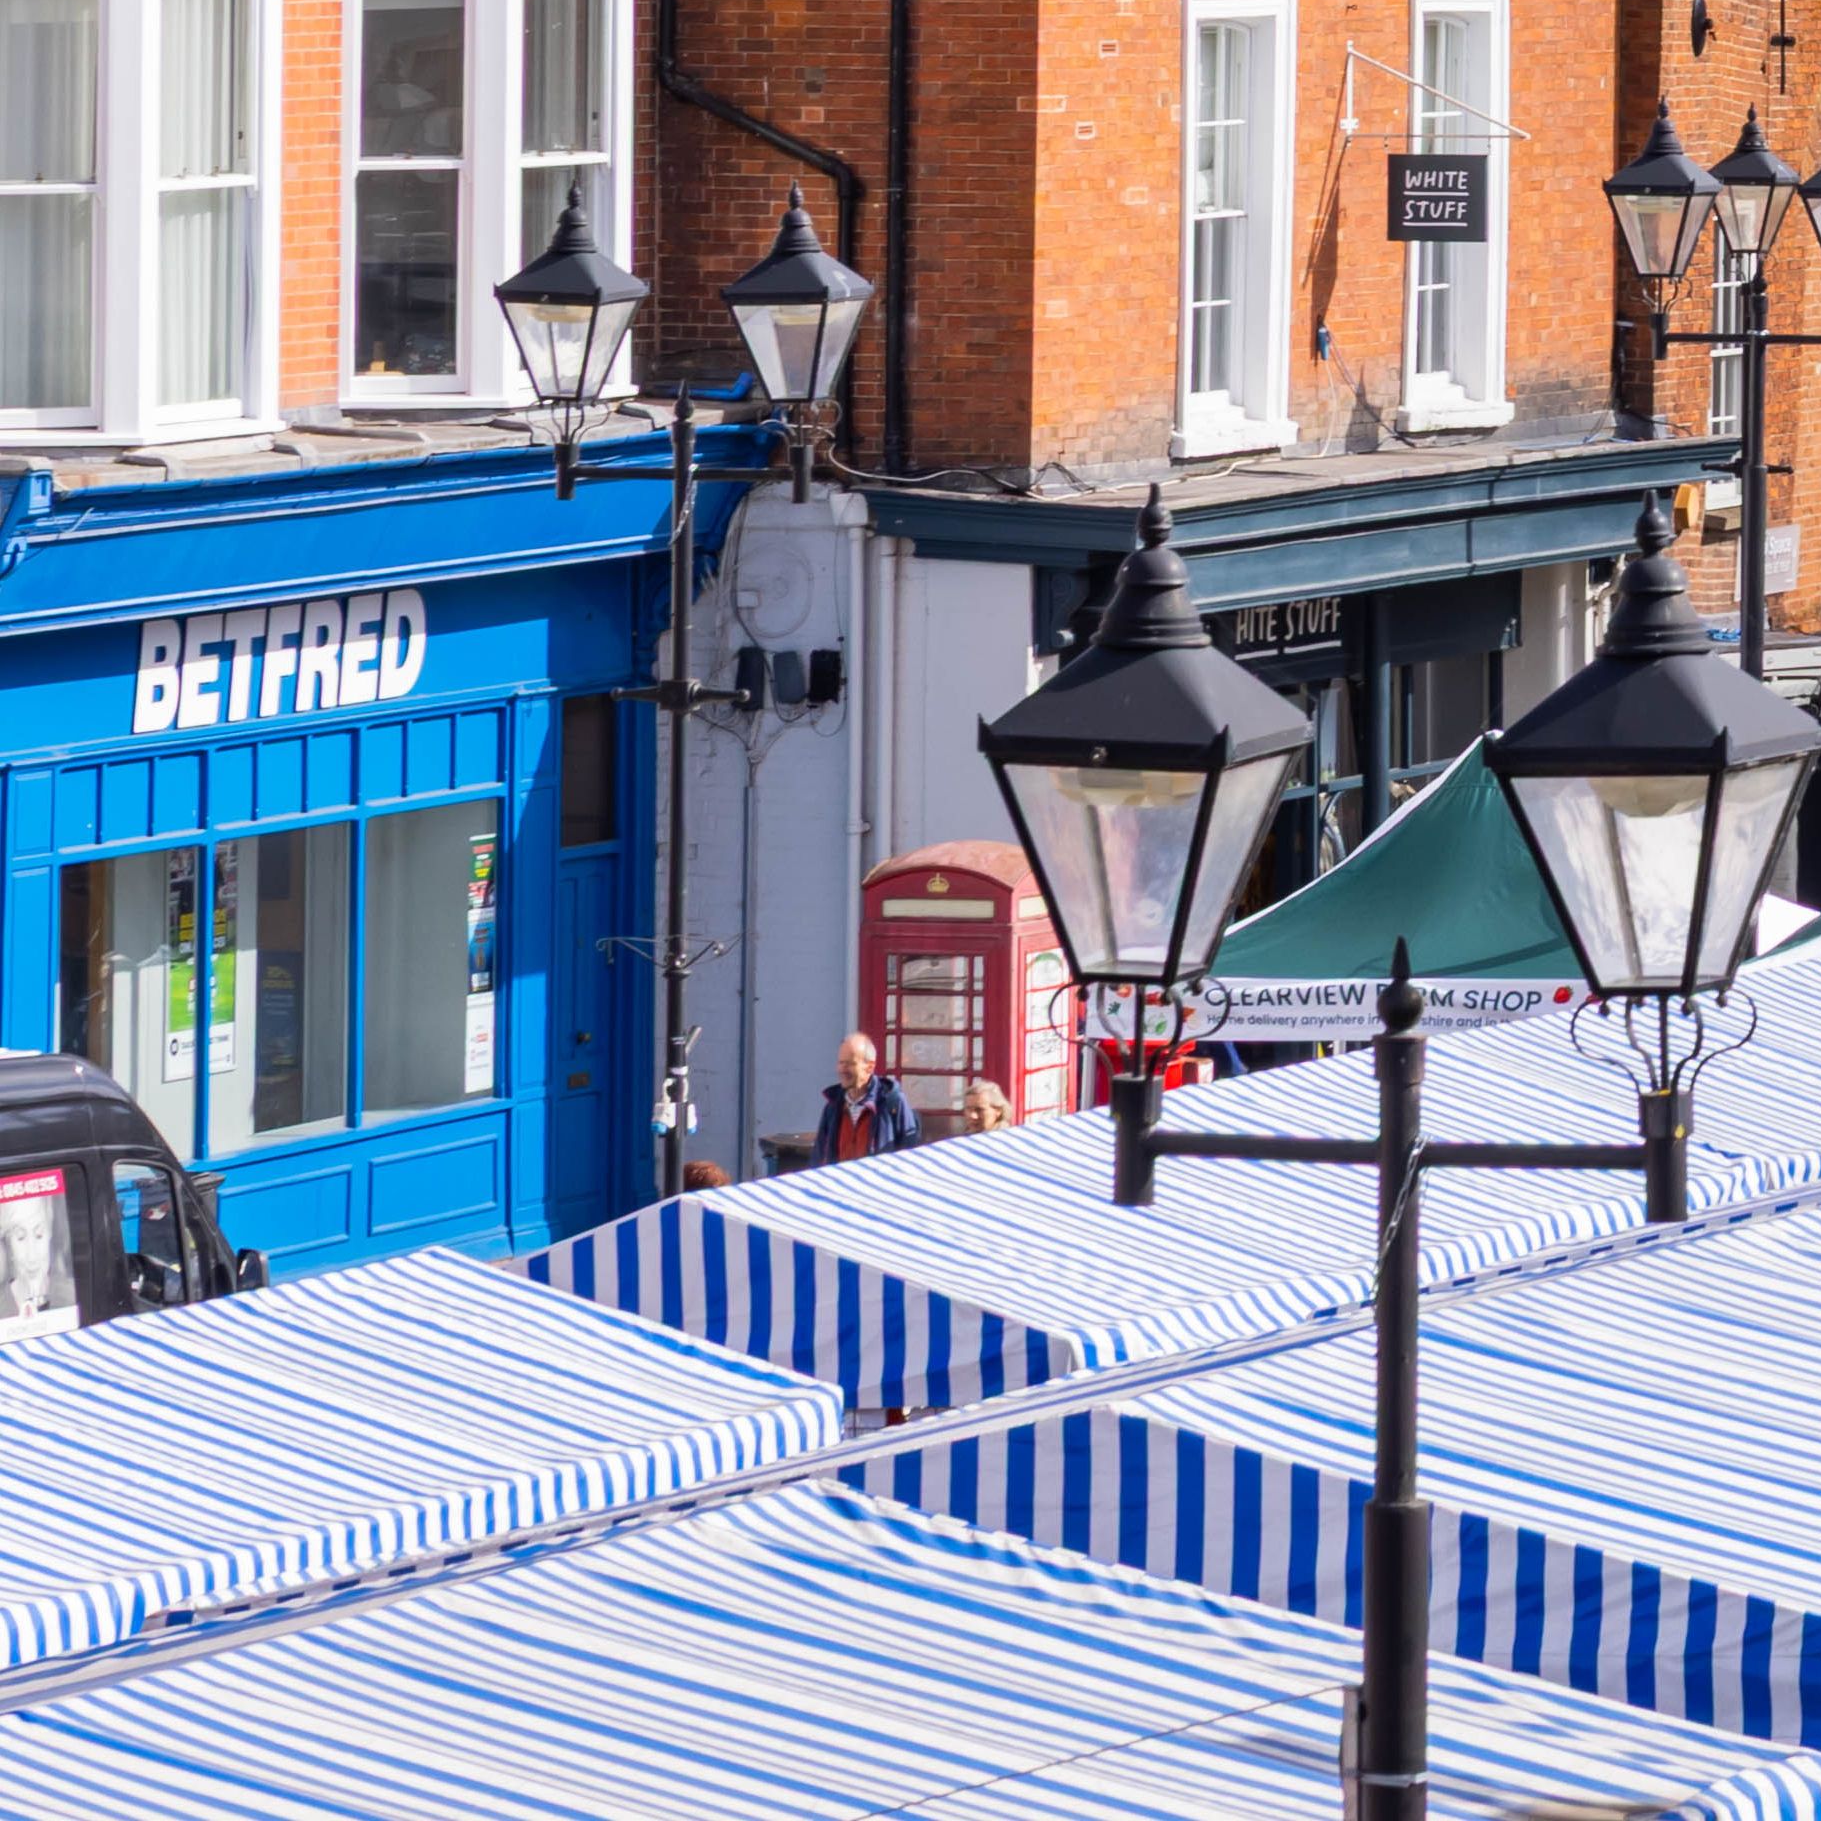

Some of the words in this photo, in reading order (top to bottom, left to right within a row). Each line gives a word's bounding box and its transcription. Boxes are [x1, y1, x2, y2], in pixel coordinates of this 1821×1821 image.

[1405, 169, 1469, 189] WHITE
[1403, 200, 1468, 219] STUFF
[1235, 605, 1278, 645] HITE
[1284, 597, 1341, 641] STUFF
[133, 589, 426, 734] BETFRED
[1205, 983, 1367, 1007] CLEARVIEW
[1463, 989, 1542, 1012] SHOP
[1247, 1013, 1297, 1028] delivery
[1300, 1013, 1365, 1028] anywhere
[1456, 1016, 1482, 1029] and
